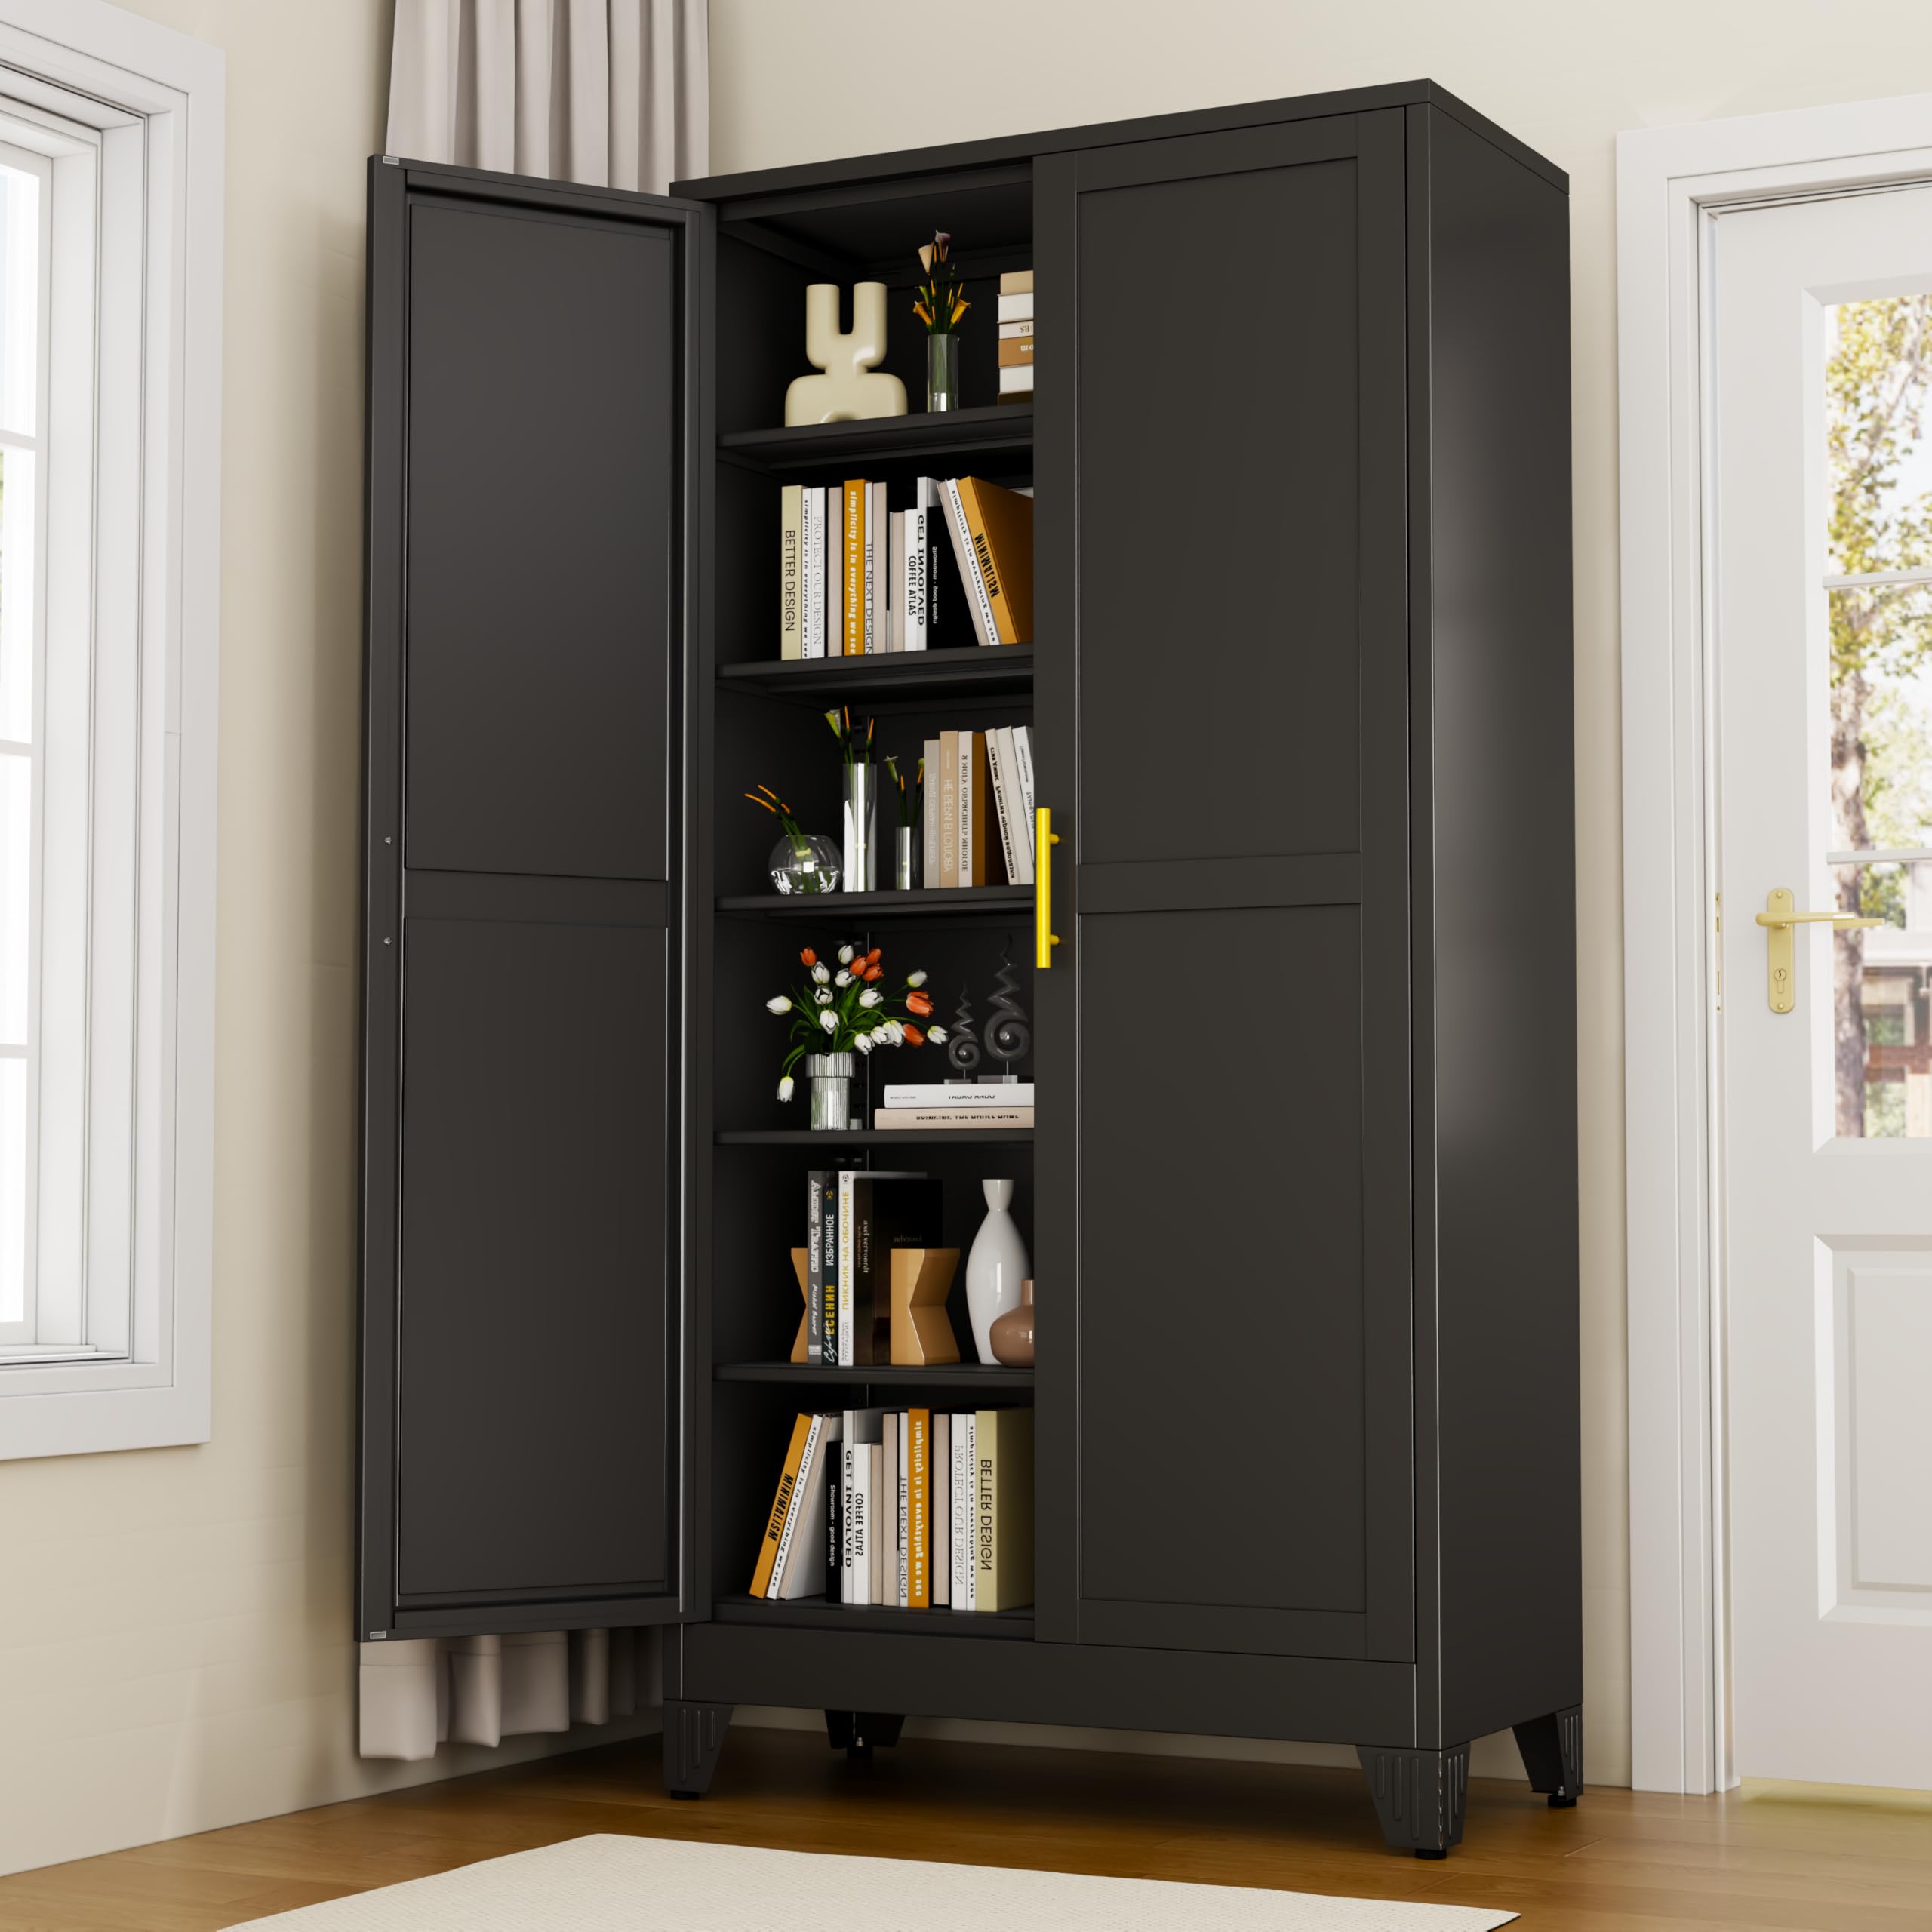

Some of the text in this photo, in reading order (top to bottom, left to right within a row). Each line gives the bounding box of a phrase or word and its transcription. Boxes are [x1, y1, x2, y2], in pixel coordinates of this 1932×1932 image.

[848, 491, 858, 540] simplicity
[850, 542, 858, 551] is
[850, 553, 858, 564] in
[784, 530, 796, 632] BETTER DESIGN
[814, 516, 822, 645] PROTECT OUR DESIGN
[848, 567, 858, 619] everything
[908, 555, 917, 616] COFFEE ATLAS
[849, 621, 857, 635] we
[826, 1214, 834, 1266] ИЗБРАННОЕ
[842, 1247, 849, 1261] НА
[801, 1426, 817, 1475] simplicity
[768, 1473, 793, 1541] MINIMALISM
